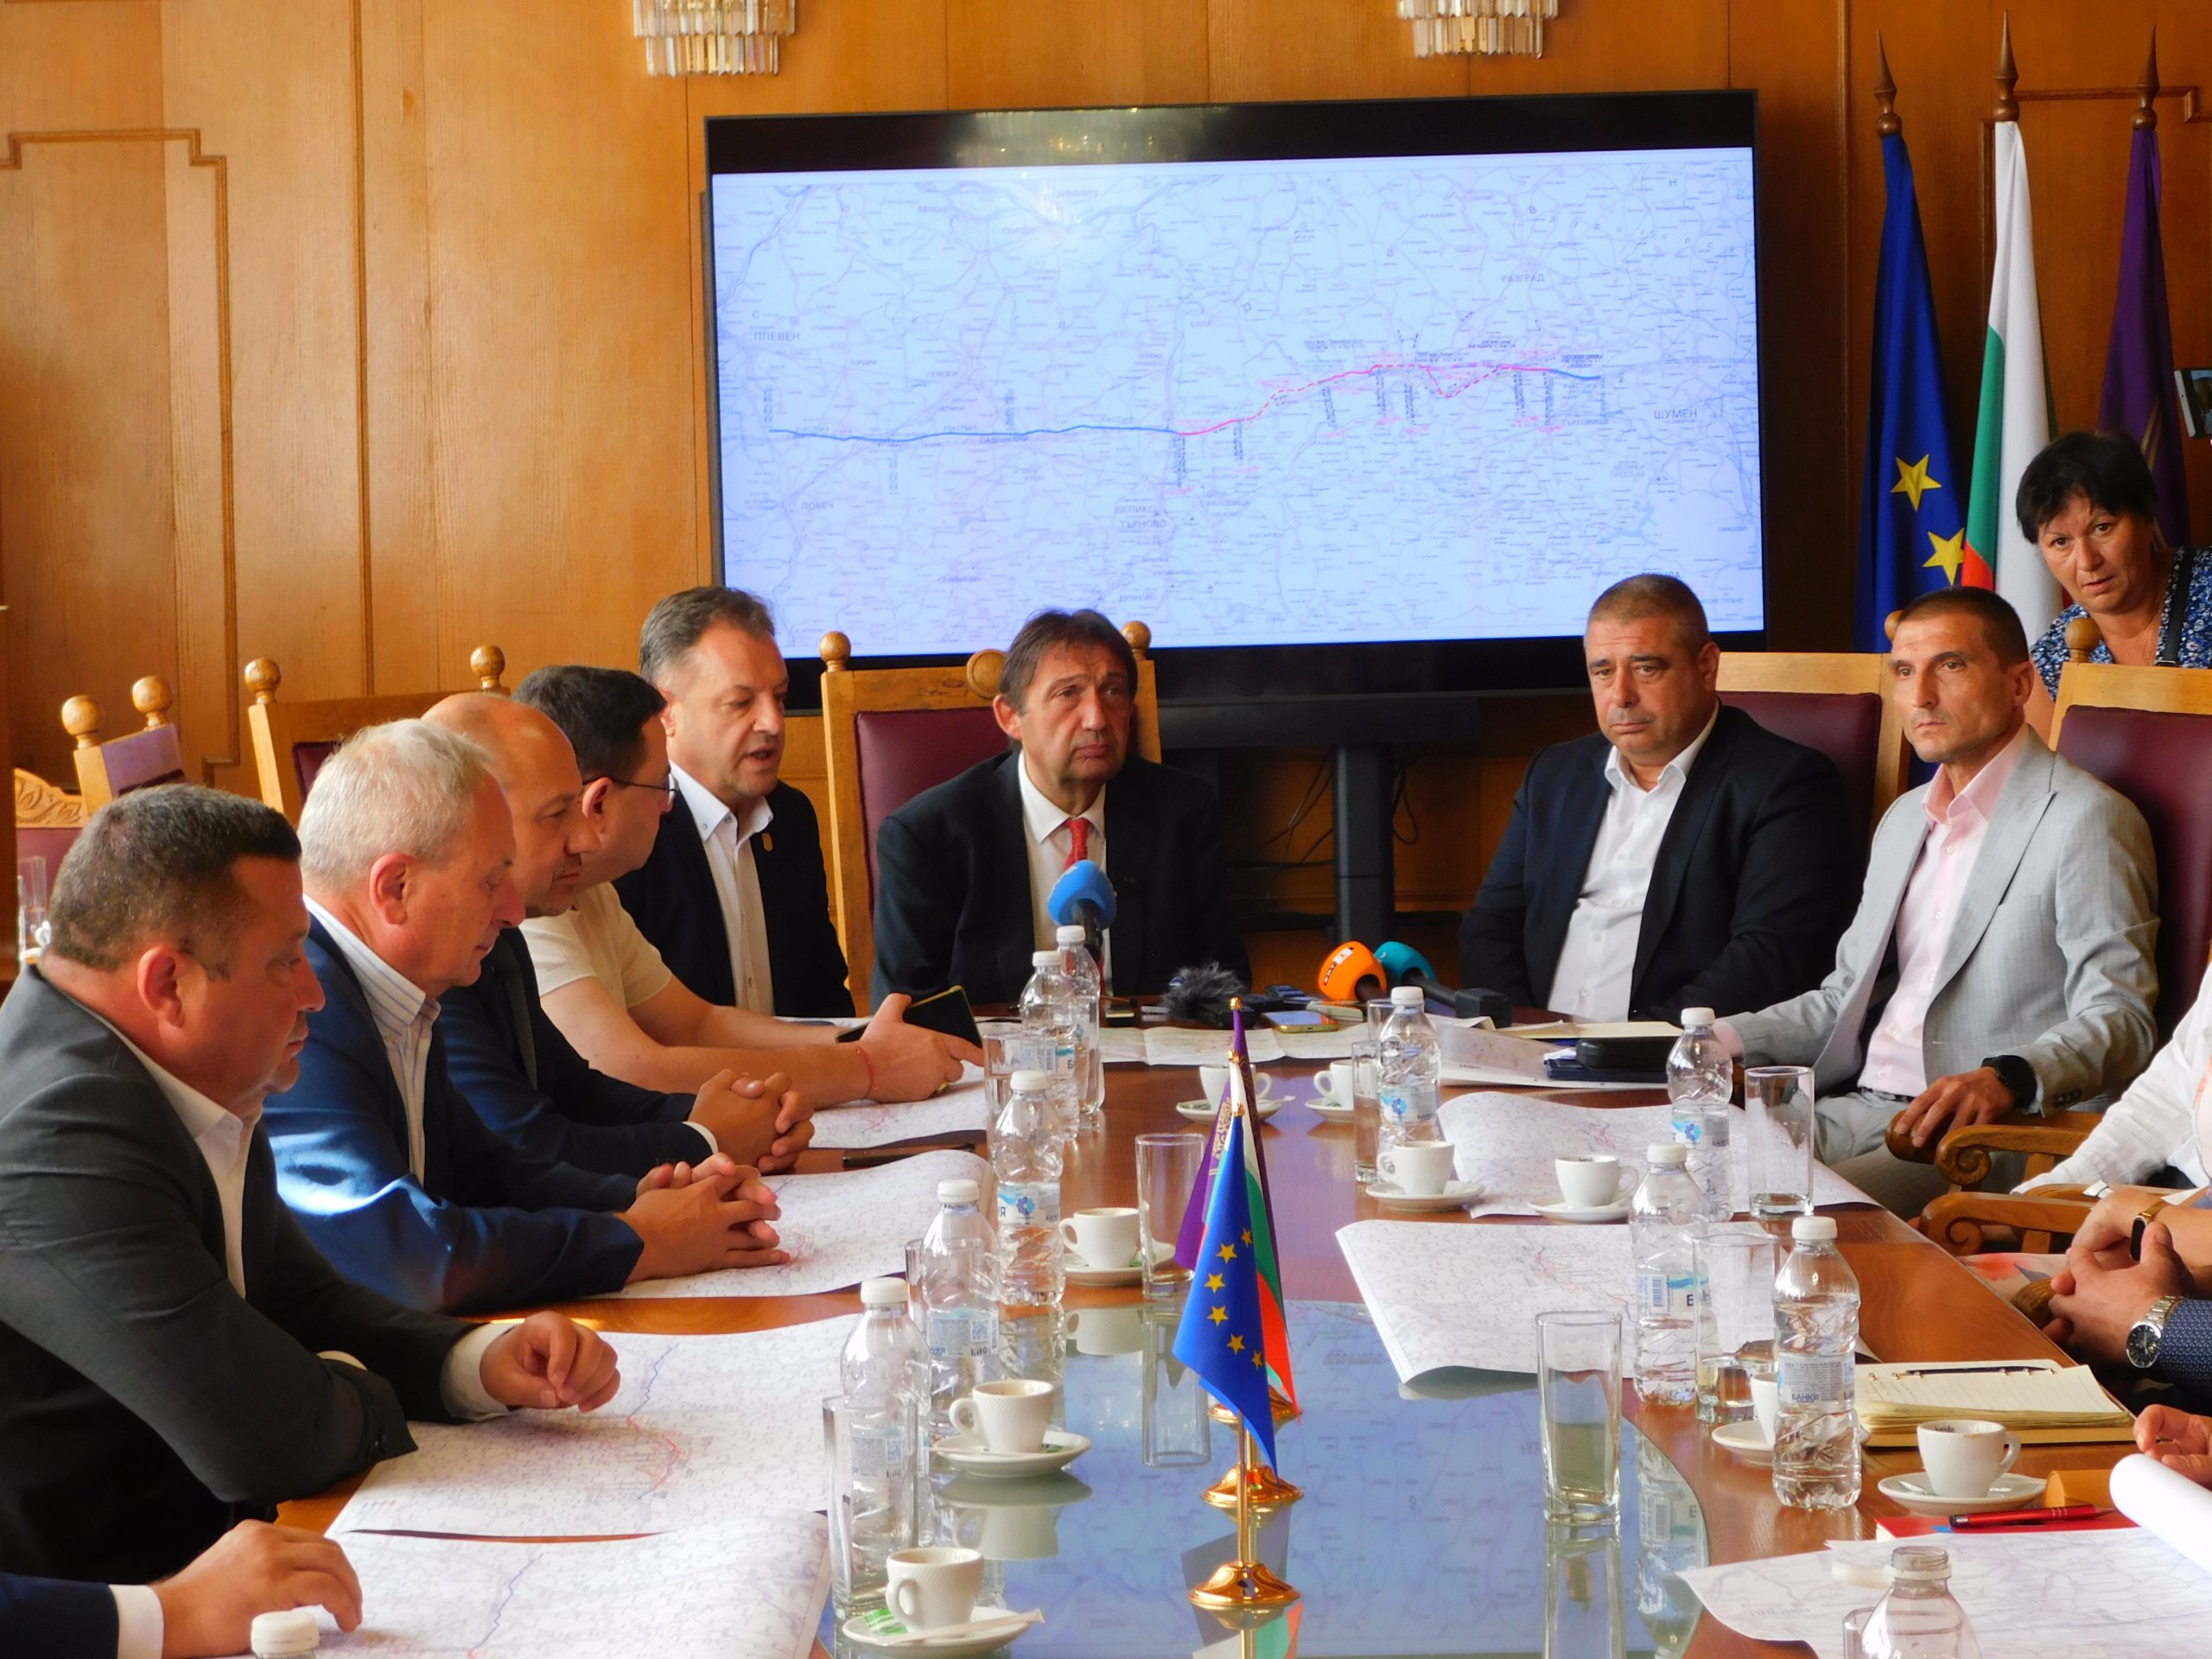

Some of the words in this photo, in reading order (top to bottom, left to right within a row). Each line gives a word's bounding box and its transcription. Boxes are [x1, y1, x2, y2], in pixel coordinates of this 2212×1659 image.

[1500, 273, 1545, 283] РАЗГРАД
[753, 331, 800, 342] ПЛЕВЕН
[1654, 409, 1698, 420] ШУМЕН
[1791, 1392, 1819, 1401] БАНКЯ
